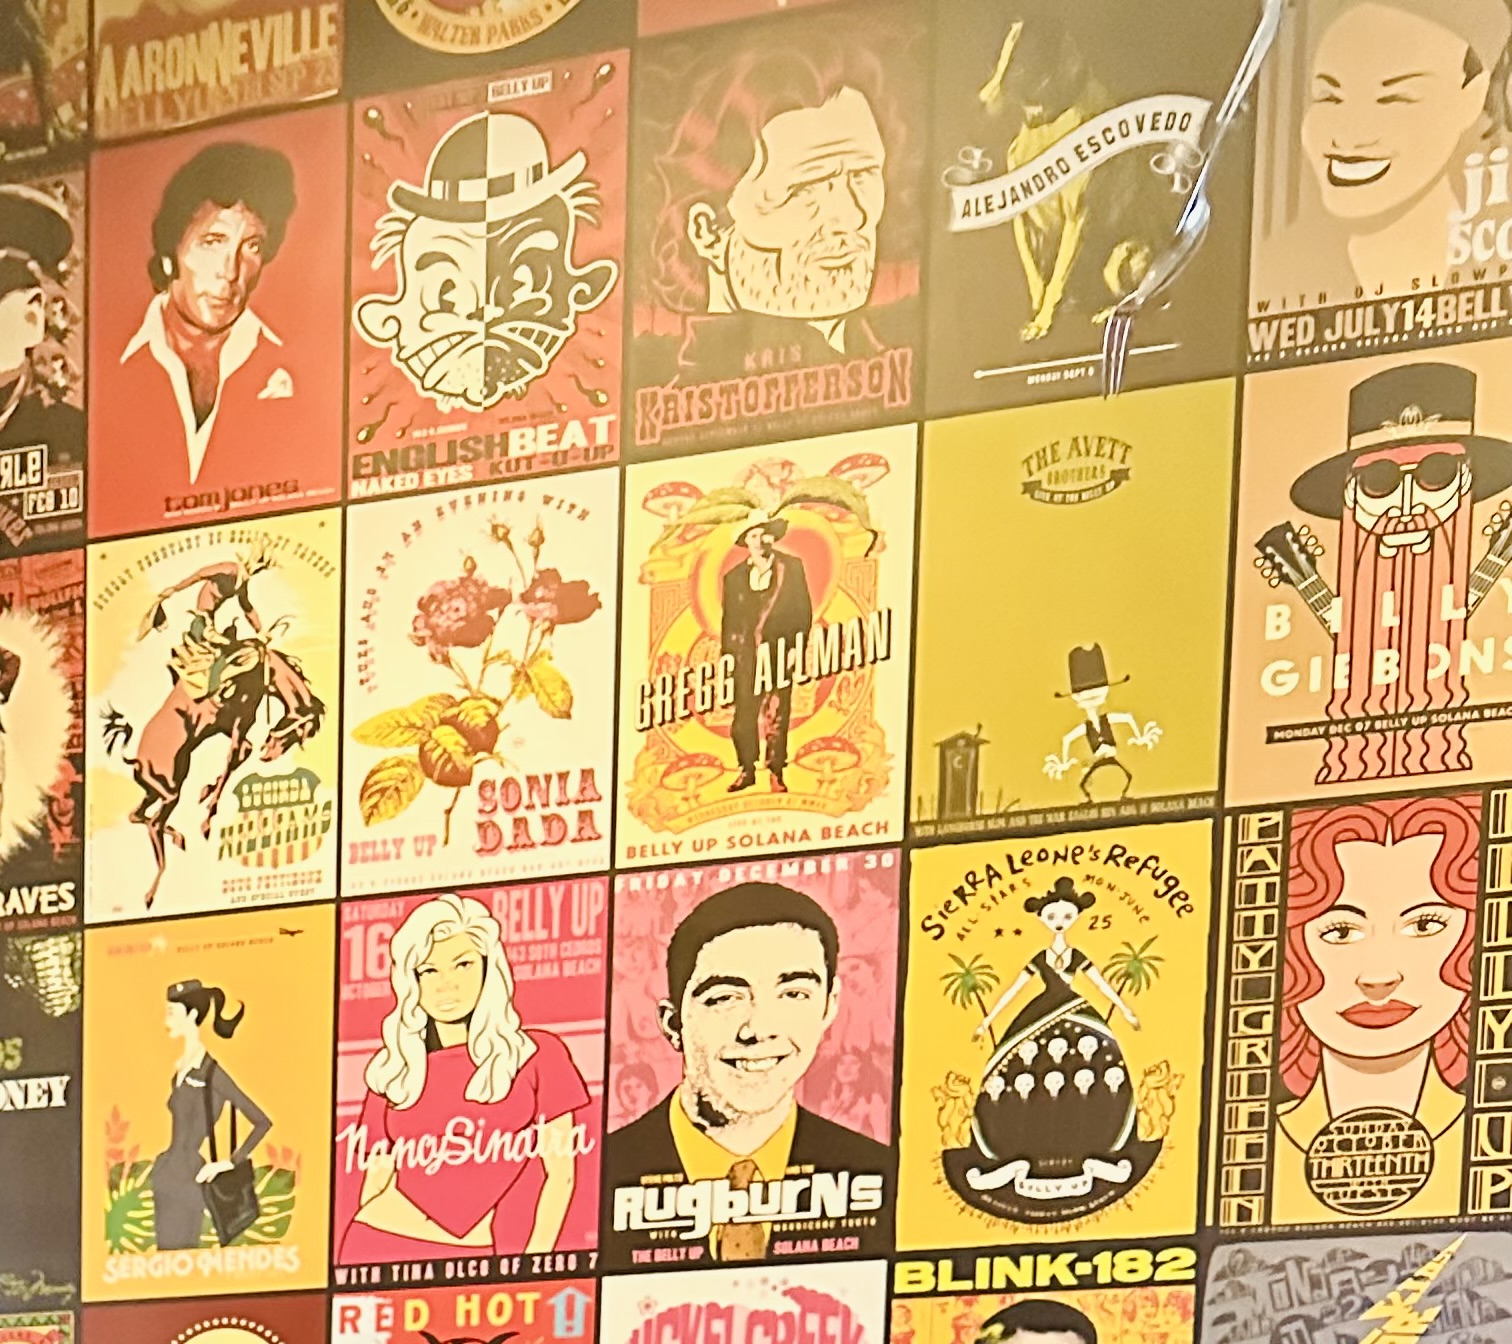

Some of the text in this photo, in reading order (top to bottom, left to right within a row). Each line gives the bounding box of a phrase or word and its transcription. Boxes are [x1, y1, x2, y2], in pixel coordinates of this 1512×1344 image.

[416, 11, 545, 46] WALTER PARKS
[491, 76, 550, 98] BELLY UP
[959, 109, 1194, 220] ALEJANDRO ESCOVEDO
[1256, 292, 1327, 313] WITH
[1248, 313, 1316, 353] WED
[1324, 299, 1402, 343] JULY
[1400, 296, 1438, 332] 14
[744, 344, 803, 371] KRIS
[634, 348, 913, 446] KRISTOFFERSON
[352, 413, 617, 480] ENGLISH BEAT
[1021, 434, 1133, 479] THE AVETT
[350, 464, 474, 499] NAKED EYES
[1046, 462, 1107, 488] BROTHERS
[633, 606, 893, 733] GREGG ALLMAN
[1273, 707, 1481, 740] MONDAY DEC BELLY UP SOLANA
[476, 766, 603, 816] SONIA
[348, 833, 438, 866] BELLY UP
[473, 809, 603, 857] DADA
[626, 836, 682, 860] BELLY
[690, 835, 718, 855] UP
[726, 828, 811, 852] SOLANA
[821, 820, 890, 842] BEACH
[614, 870, 704, 895] FRIDAY
[717, 854, 850, 884] DECEMBER
[863, 850, 896, 872] 30
[492, 879, 606, 937] BELLY UP
[1088, 912, 1113, 932] 25
[343, 921, 395, 985] 16
[557, 940, 604, 960] CEDROS
[560, 956, 603, 978] BEACH
[1311, 1132, 1431, 1157] OCTOBER
[1308, 1153, 1431, 1179] THIRTEENTH
[101, 1244, 301, 1284] SERGIO MENDES
[631, 1236, 860, 1264] THE BELLY UP SOLANA BEACH
[335, 1253, 579, 1286] WITH TINA OF ZERO
[893, 1246, 1196, 1296] BLINK-182
[338, 1290, 543, 1336] RED HOT
